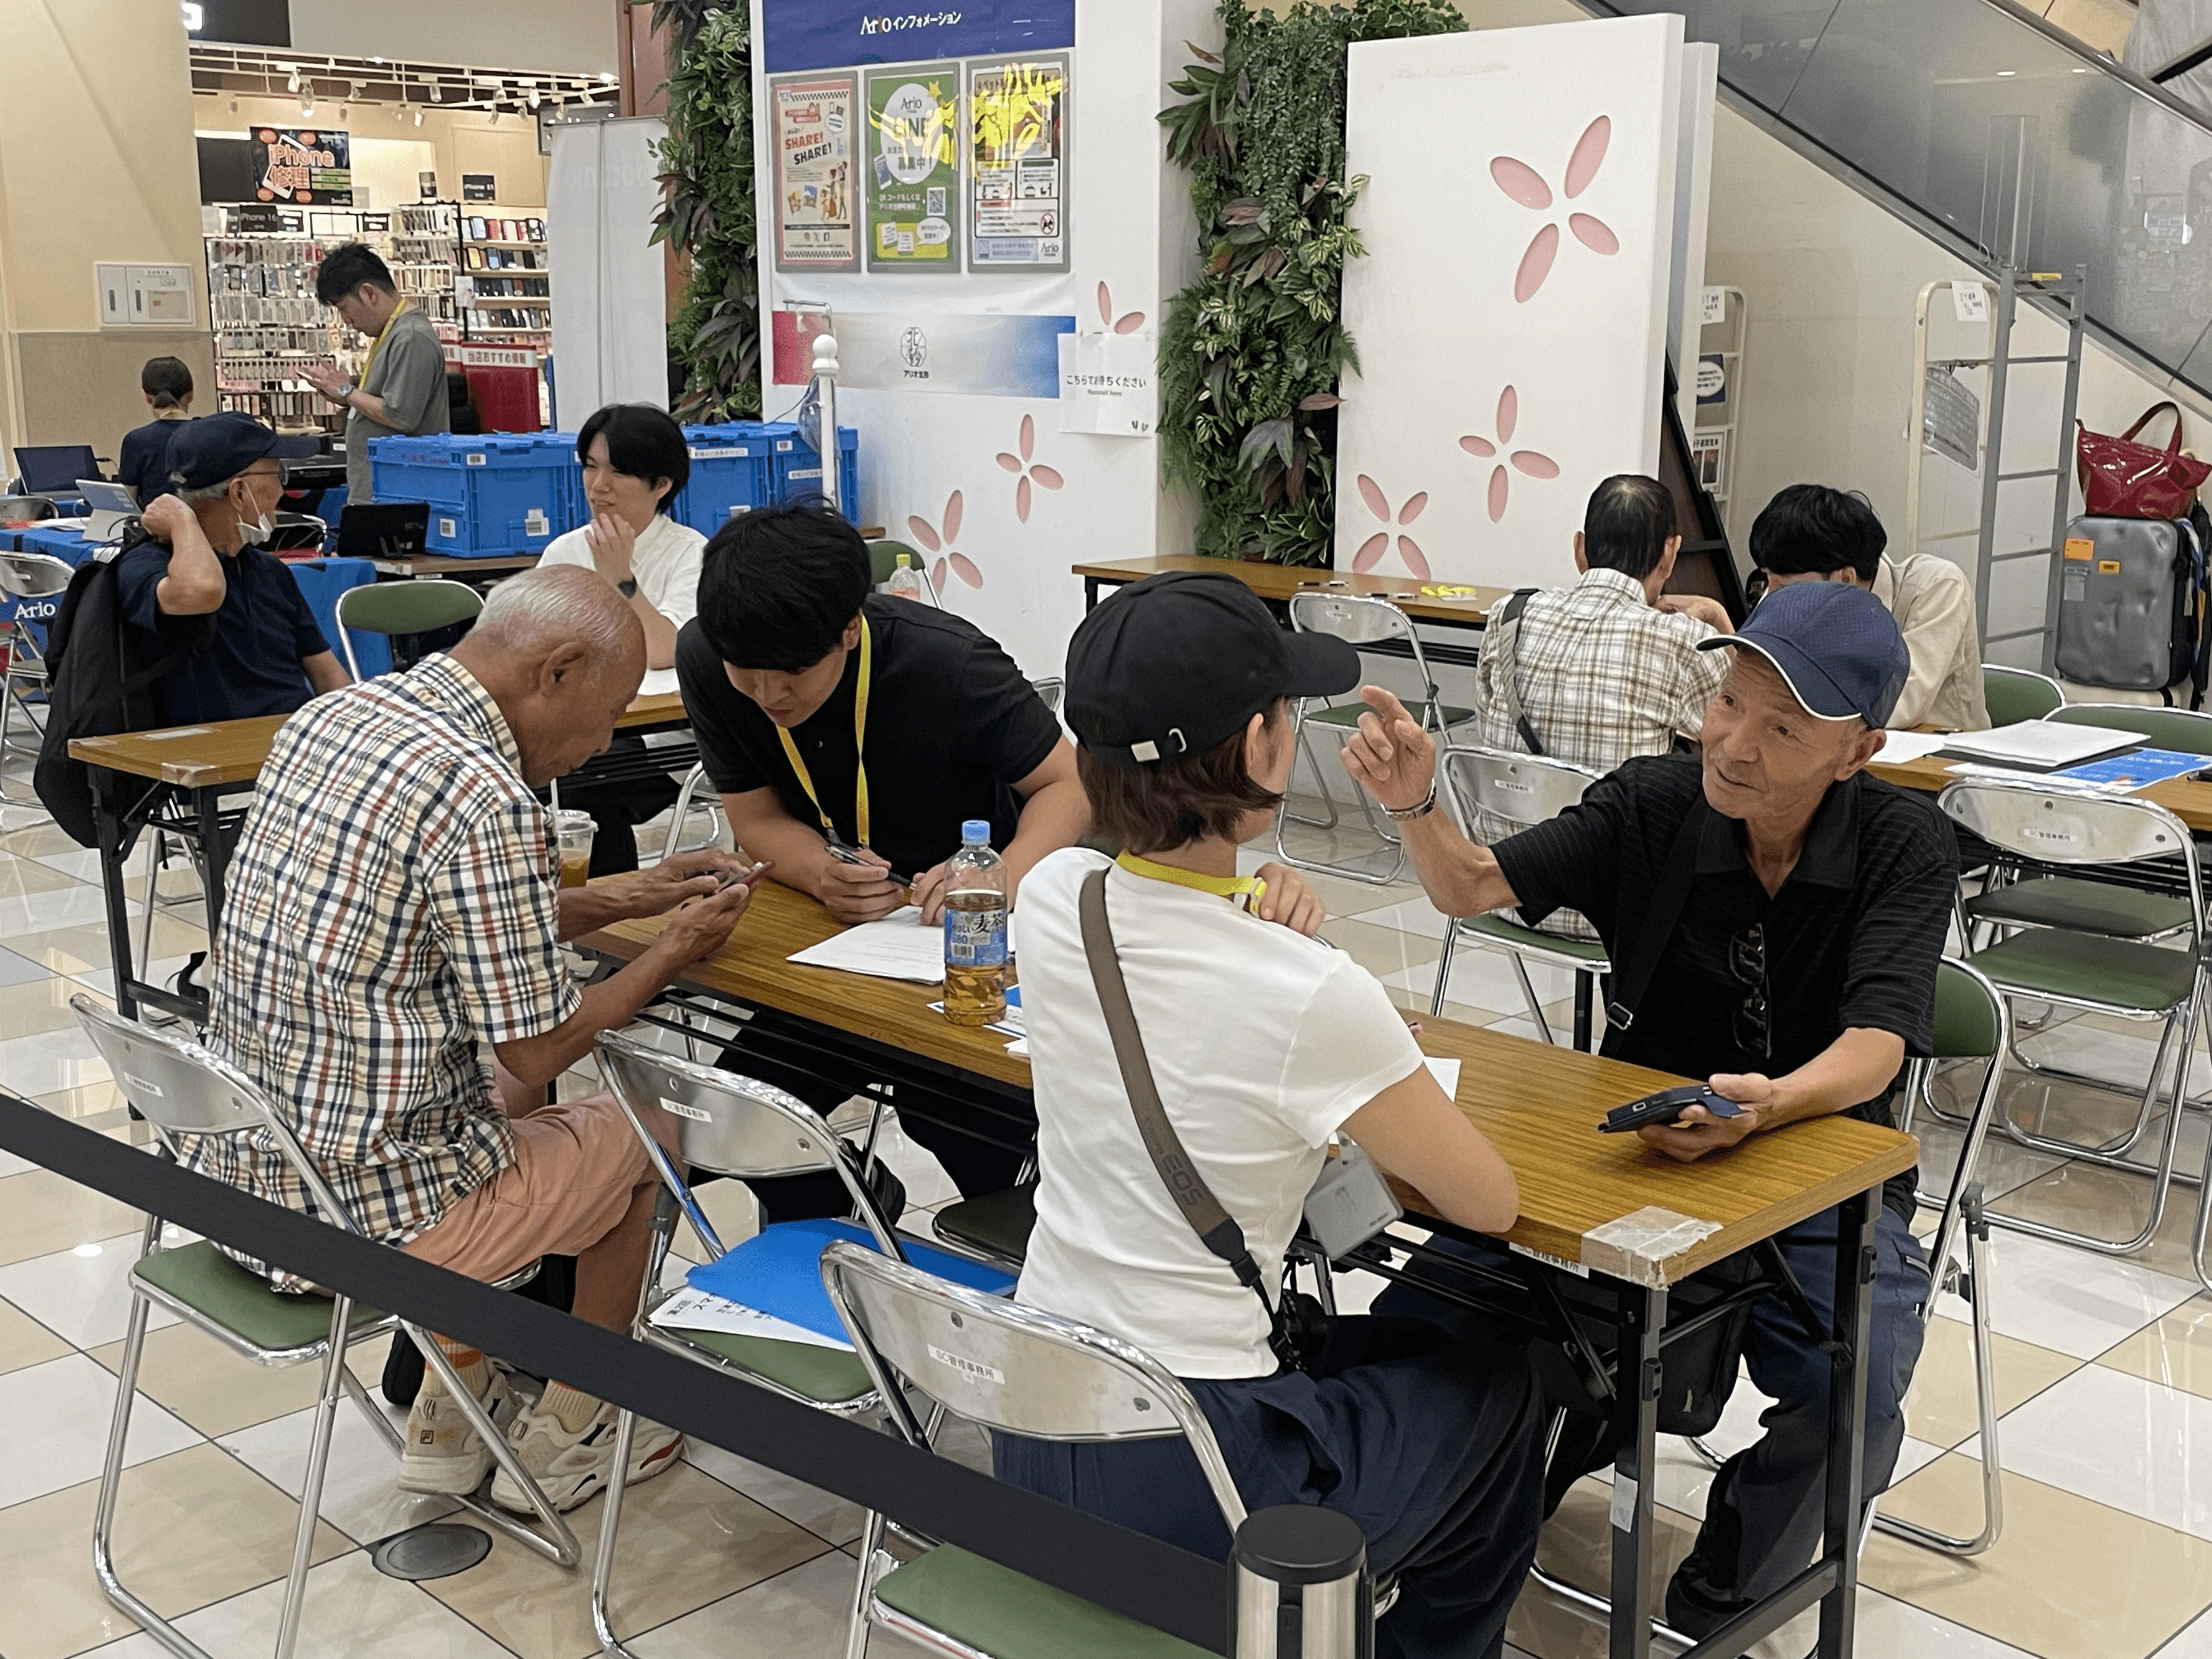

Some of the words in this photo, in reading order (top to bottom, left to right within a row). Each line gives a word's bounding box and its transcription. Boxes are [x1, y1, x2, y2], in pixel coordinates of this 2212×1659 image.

[900, 96, 922, 109] Ario
[785, 131, 823, 150] SHARE!
[268, 143, 335, 167] iPhone
[794, 142, 832, 165] SHARE!
[270, 165, 310, 188] 修理
[14, 601, 56, 620] Ario
[1162, 1153, 1205, 1206] EOS
[935, 1349, 995, 1381] SC管理事務所
